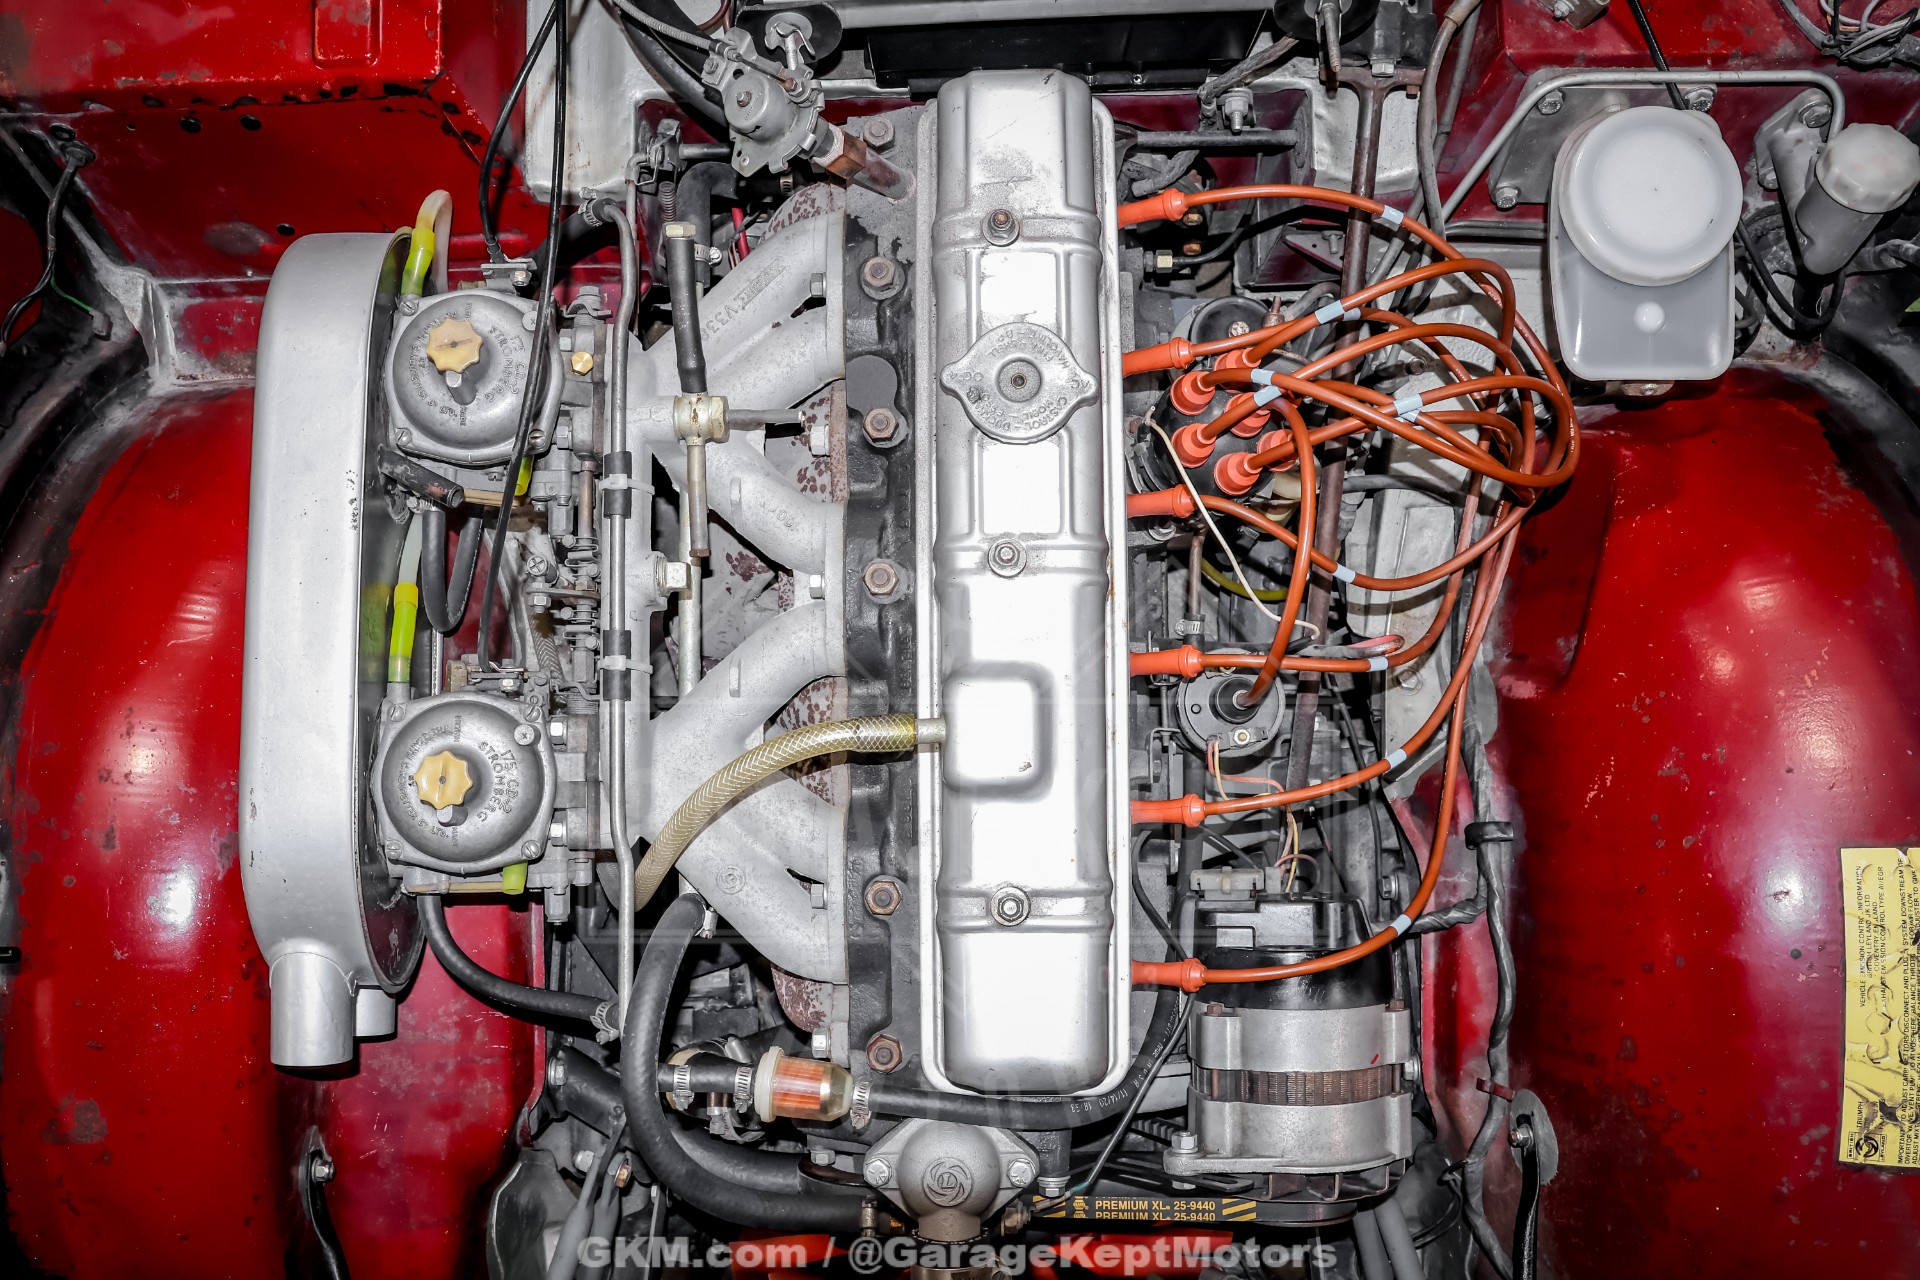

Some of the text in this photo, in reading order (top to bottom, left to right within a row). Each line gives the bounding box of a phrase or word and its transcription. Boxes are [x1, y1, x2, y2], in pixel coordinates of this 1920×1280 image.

[1025, 396, 1067, 430] CASTROL
[501, 750, 517, 770] 175
[477, 741, 504, 822] STROMBERG
[1899, 870, 1907, 916] DOWNSTREAM
[1913, 887, 1918, 895] TO
[1096, 1201, 1148, 1210] PREMIUM
[1173, 1201, 1216, 1211] 25-9440
[1173, 1212, 1216, 1221] 25-9440
